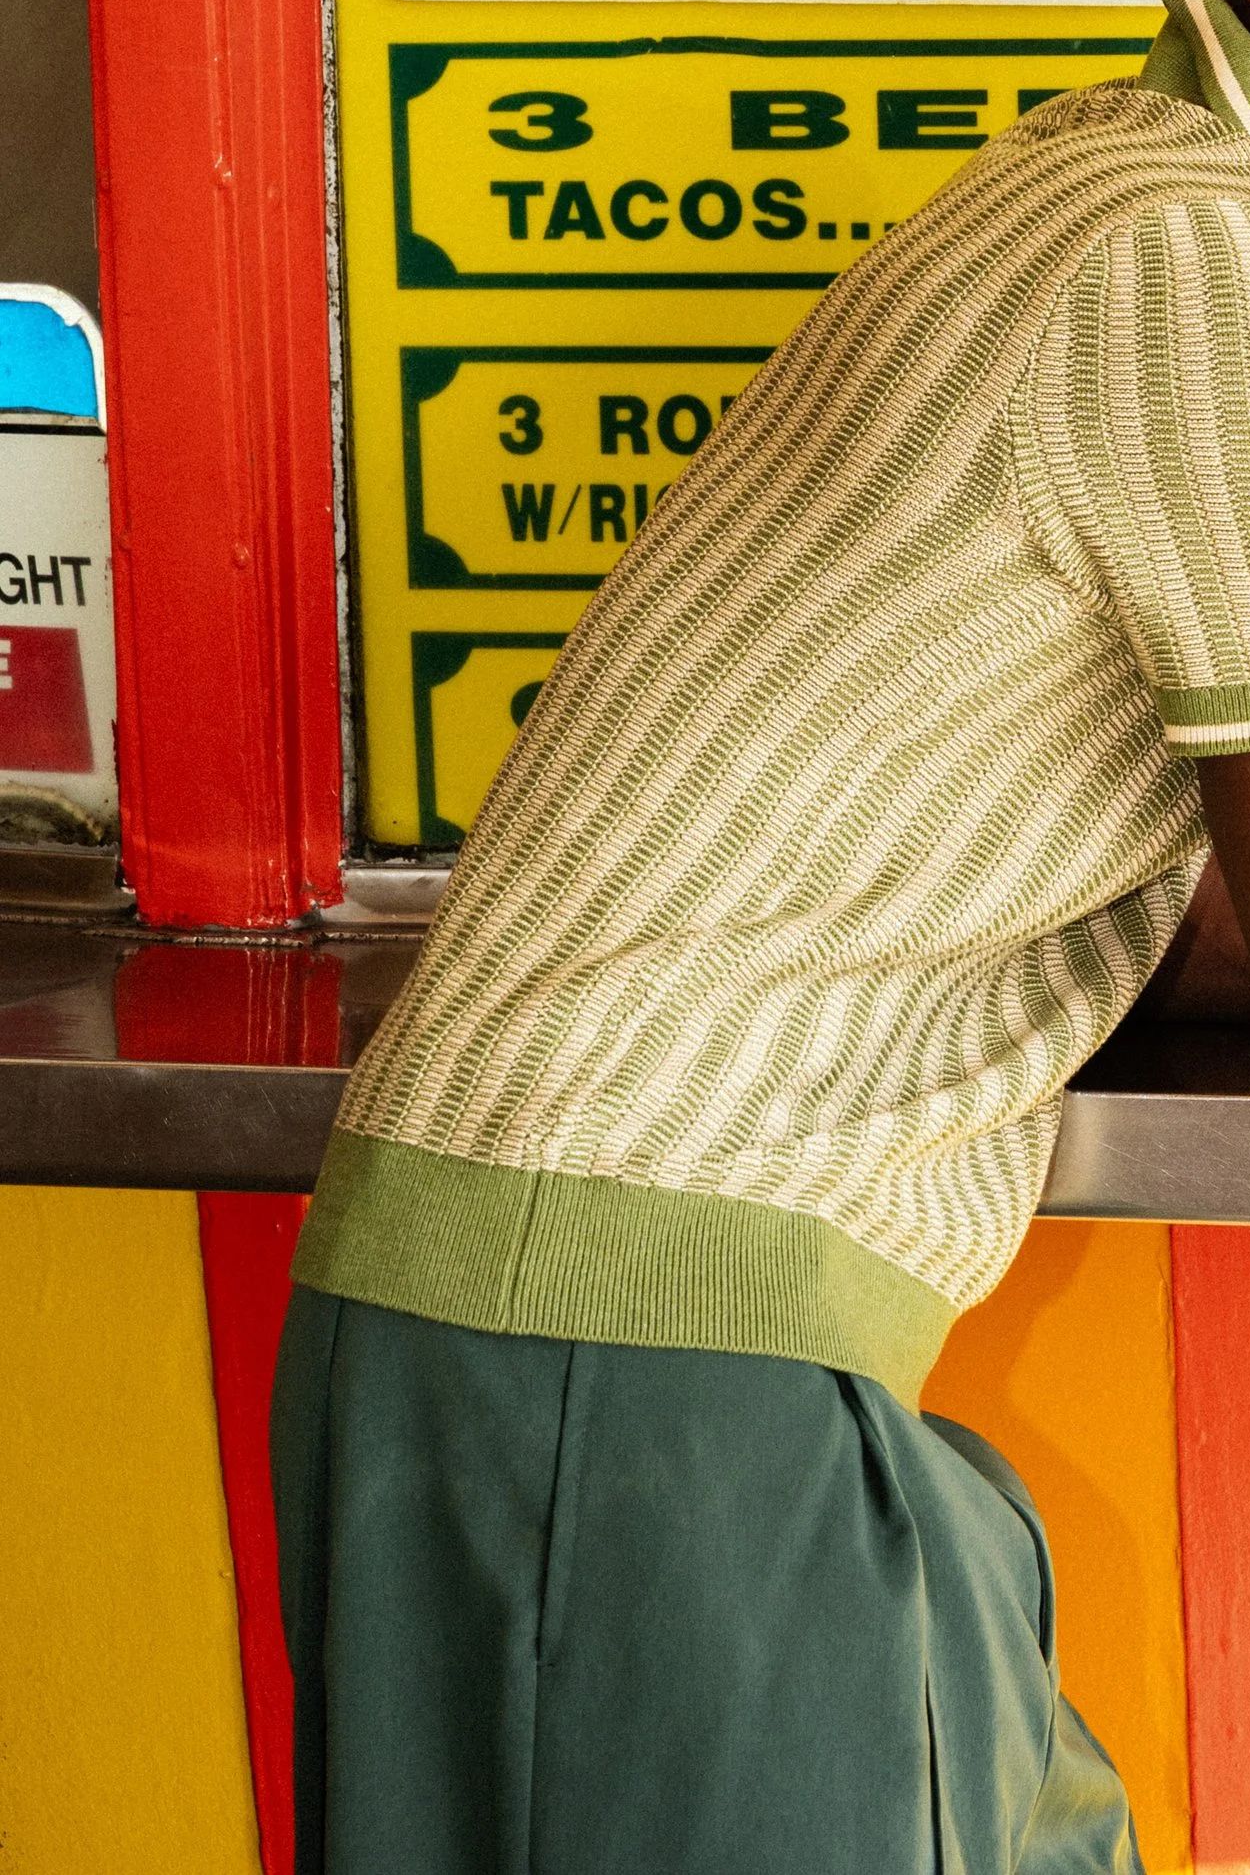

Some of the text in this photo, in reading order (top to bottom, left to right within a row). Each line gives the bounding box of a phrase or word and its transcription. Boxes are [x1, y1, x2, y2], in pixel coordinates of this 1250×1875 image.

[488, 89, 1075, 152] 3 BE
[499, 394, 737, 456] 3 RO
[501, 483, 670, 542] W/RI
